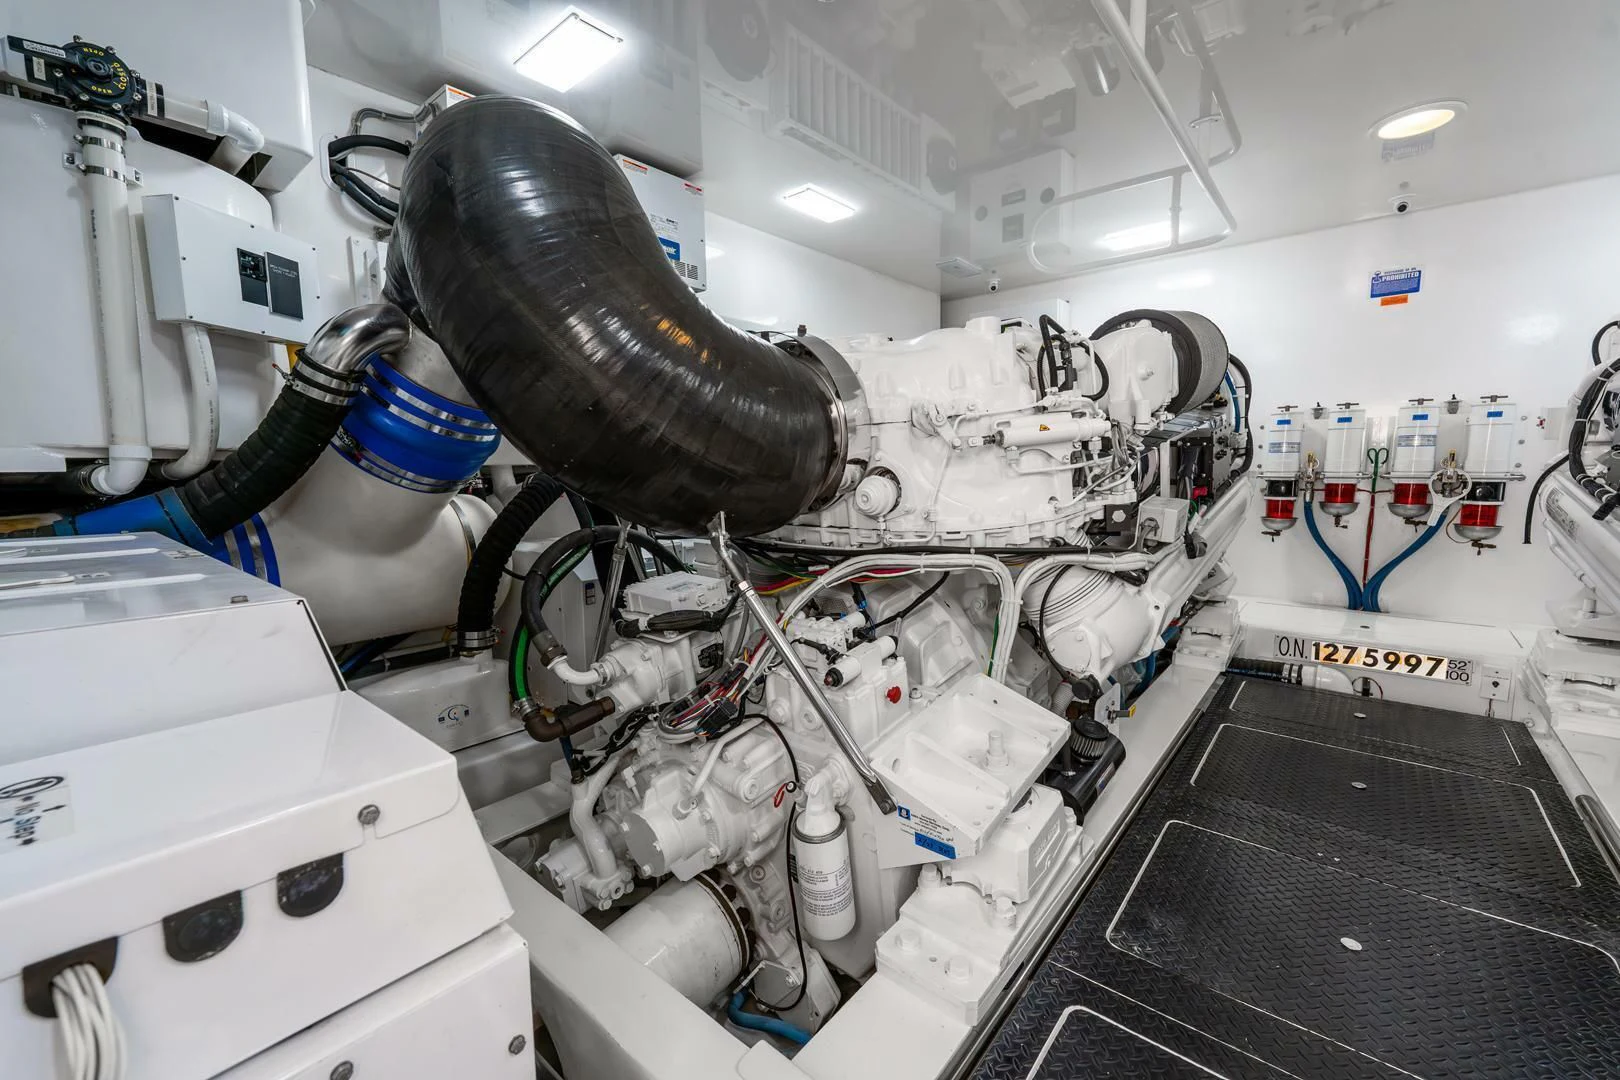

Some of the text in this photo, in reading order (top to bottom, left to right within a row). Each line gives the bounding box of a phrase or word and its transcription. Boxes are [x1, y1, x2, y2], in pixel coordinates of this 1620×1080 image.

[91, 85, 113, 94] OPEN
[1381, 272, 1419, 282] PROHIBITED
[1278, 636, 1445, 676] O.N. 1275997
[1448, 659, 1467, 670] 52
[1446, 671, 1470, 681] 100
[6, 801, 42, 839] No Step
